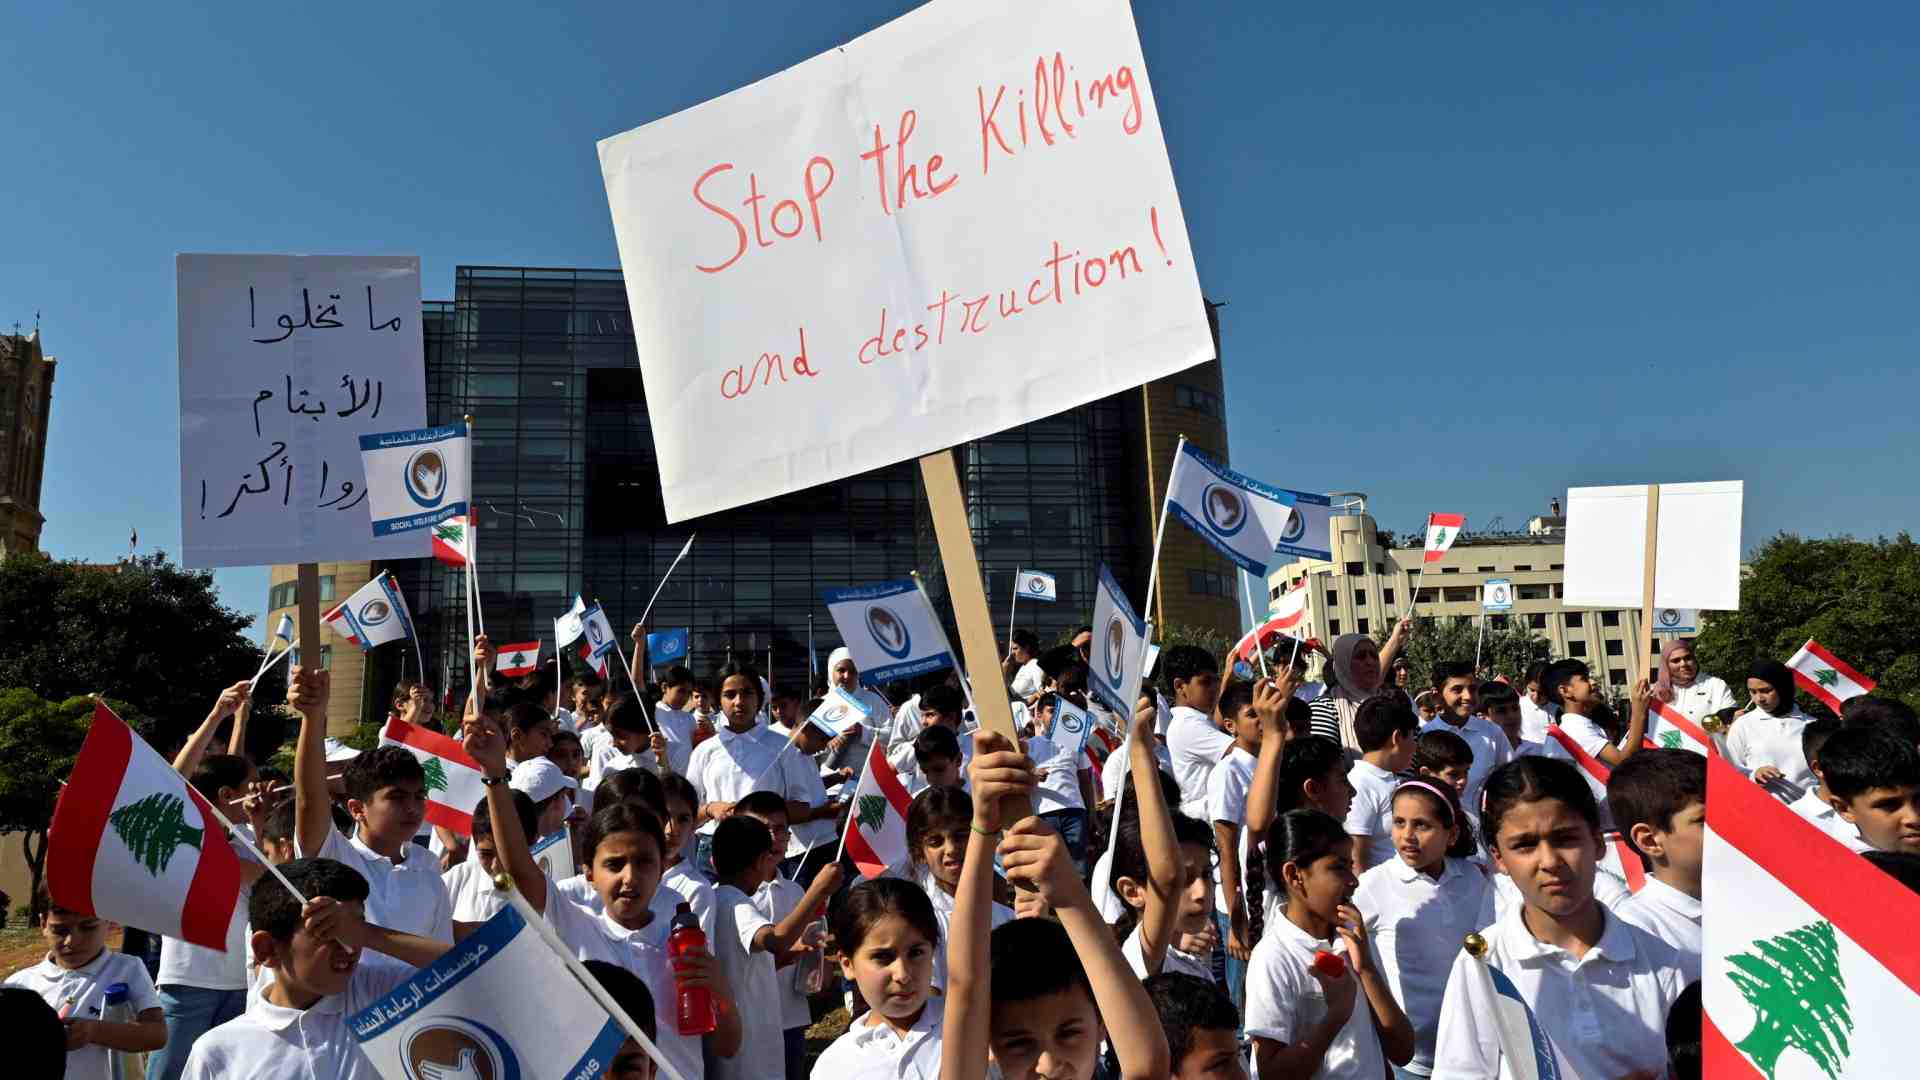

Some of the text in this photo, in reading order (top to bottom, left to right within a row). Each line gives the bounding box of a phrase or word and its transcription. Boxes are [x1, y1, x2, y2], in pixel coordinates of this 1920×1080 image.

[860, 108, 960, 216] the
[250, 285, 401, 343] ما تخلوا
[720, 327, 819, 399] and
[386, 944, 488, 1020] مؤسسات الرعاية
